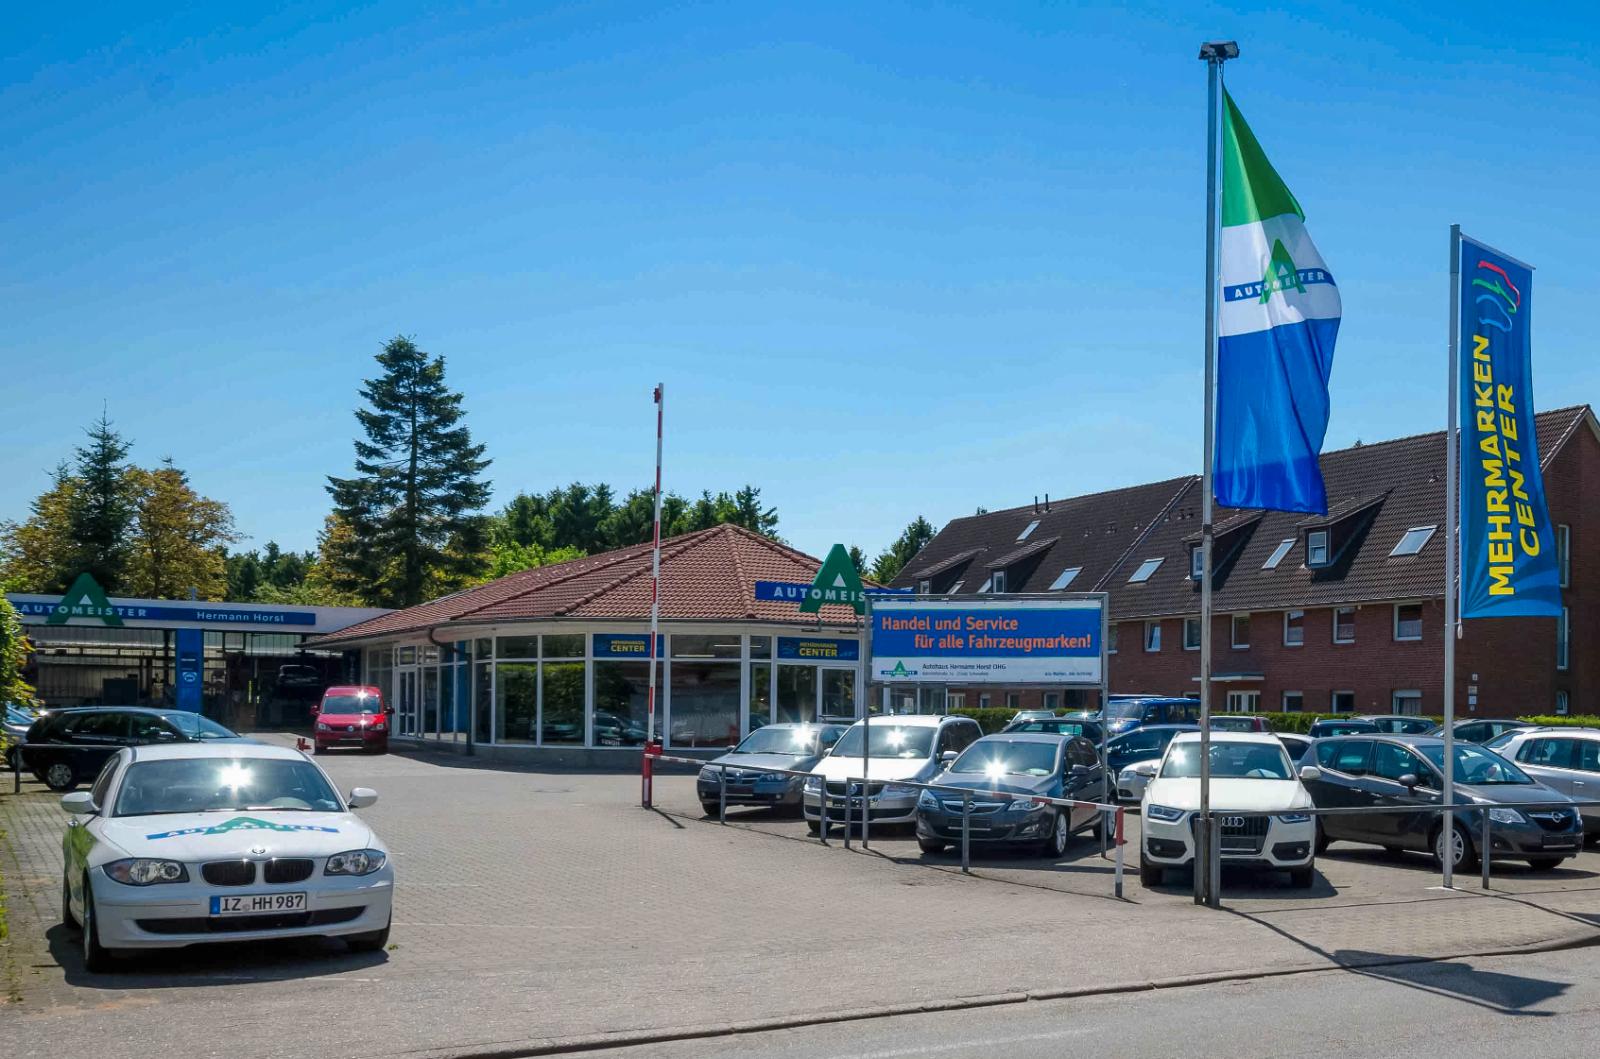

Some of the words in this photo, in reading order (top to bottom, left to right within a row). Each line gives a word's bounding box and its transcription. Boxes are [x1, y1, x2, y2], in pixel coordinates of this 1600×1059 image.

[1472, 334, 1516, 596] MEHRMARKEN
[1497, 384, 1541, 558] CENTER
[21, 604, 147, 618] AUTOMEISTER
[196, 610, 249, 622] Hermann
[253, 612, 285, 623] Horst
[881, 616, 931, 631] Handel
[935, 616, 961, 631] und
[966, 616, 1018, 631] Service
[611, 644, 645, 653] CENTER
[914, 634, 935, 649] für
[938, 634, 964, 649] alle
[968, 634, 1092, 652] Fahrzeugmarken!
[799, 647, 838, 657] CENTER
[222, 897, 242, 911] IZ
[252, 896, 273, 910] HH
[276, 894, 304, 909] 987
